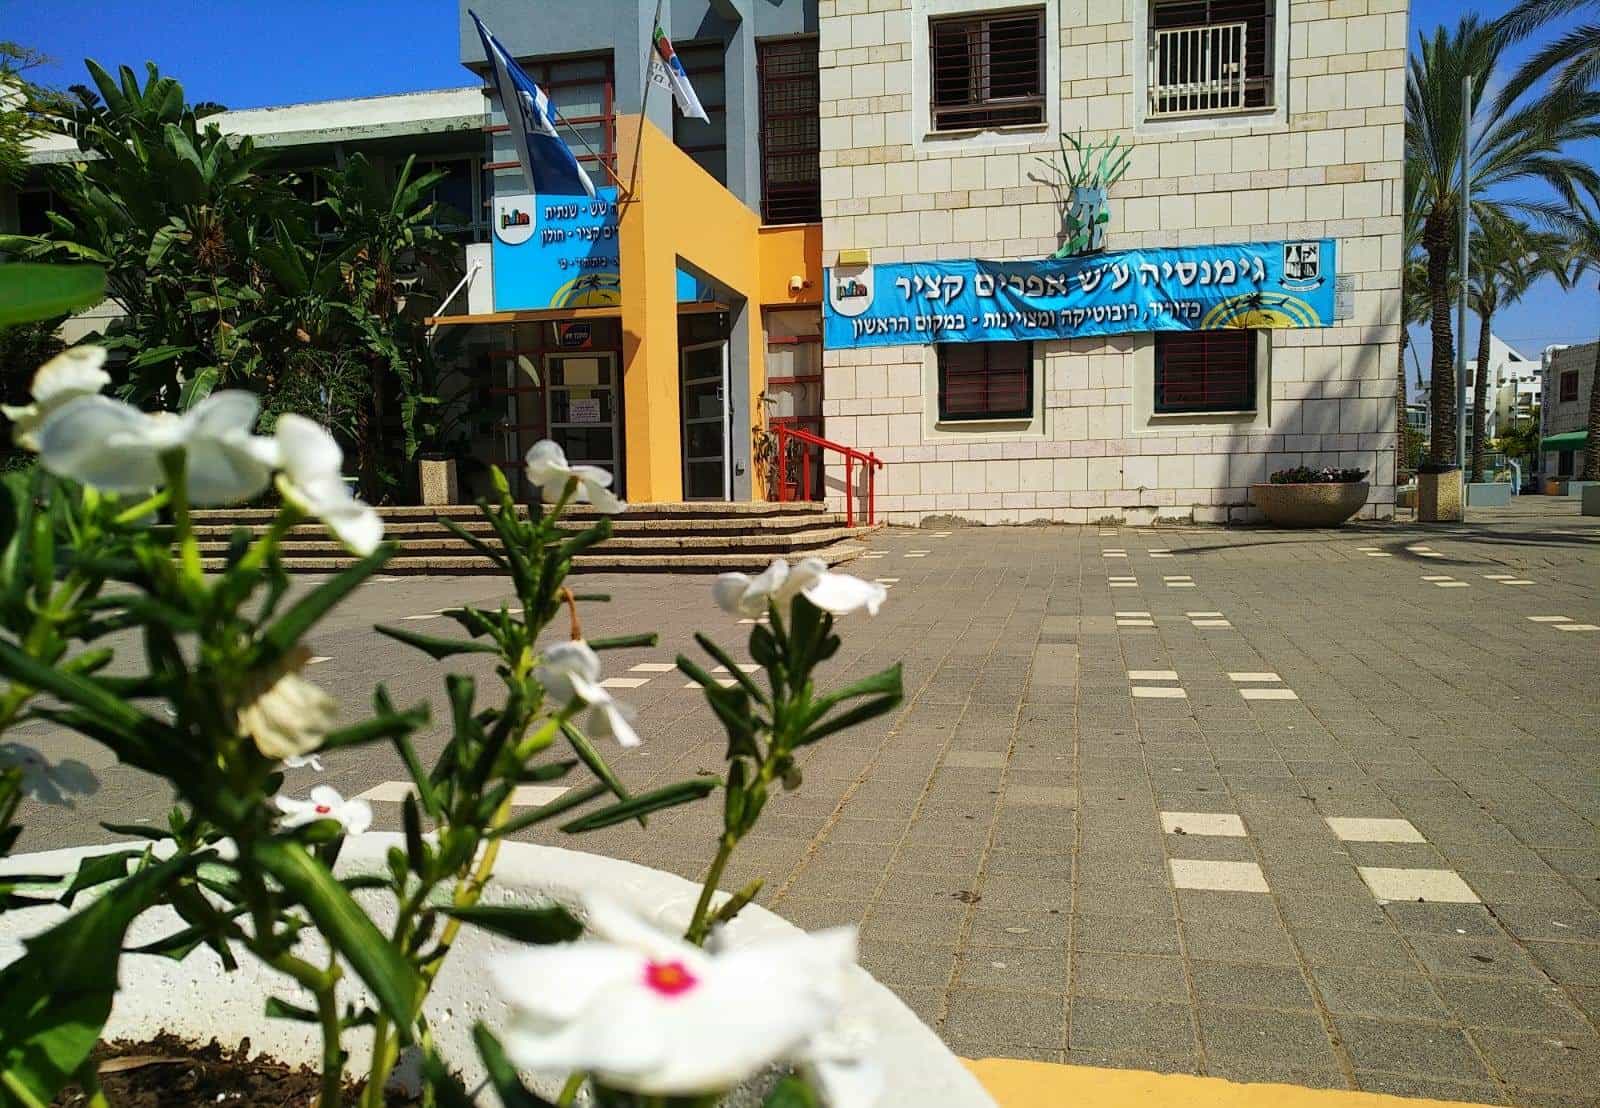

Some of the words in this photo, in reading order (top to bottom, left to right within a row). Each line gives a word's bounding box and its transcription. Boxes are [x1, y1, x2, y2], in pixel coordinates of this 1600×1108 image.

[545, 204, 577, 219] שנתית
[590, 202, 607, 216] שש
[541, 227, 565, 244] חולון
[575, 226, 600, 241] קציר
[1139, 256, 1265, 286] גימנסיה
[895, 274, 964, 306] קציר
[975, 273, 1067, 297] אפרים
[915, 313, 965, 333] במקום
[982, 311, 1056, 328] ומצויינות
[1060, 302, 1138, 328] רובוטיקה
[852, 316, 910, 339] הראשון
